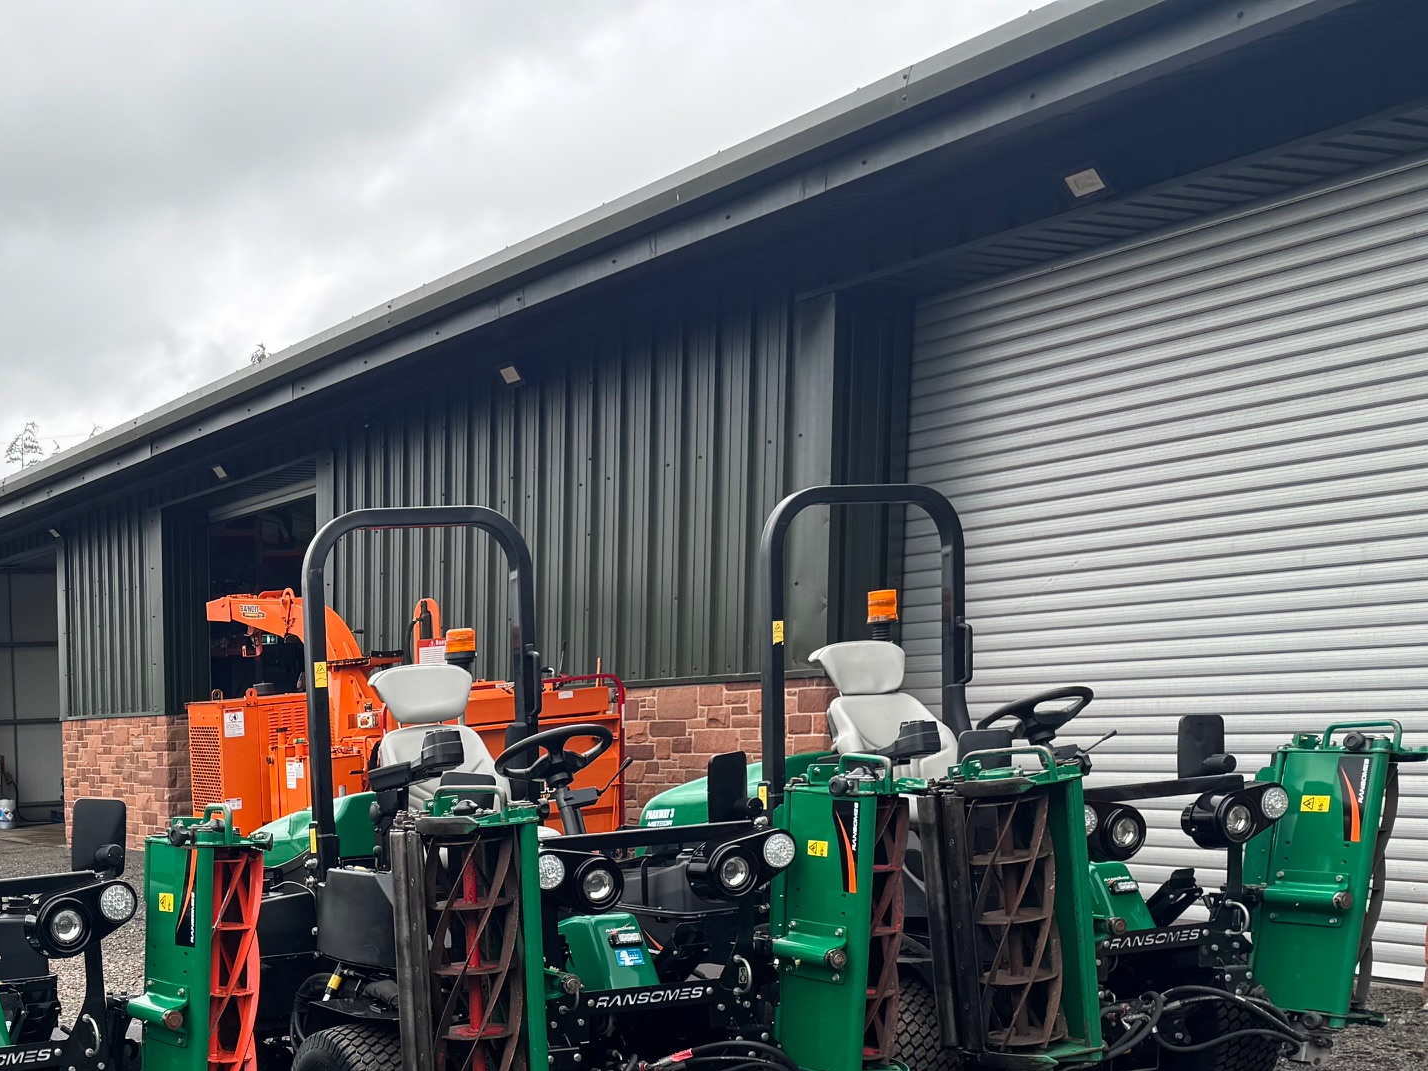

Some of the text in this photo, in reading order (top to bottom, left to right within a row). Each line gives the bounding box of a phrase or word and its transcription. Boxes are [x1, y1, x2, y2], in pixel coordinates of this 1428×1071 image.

[851, 801, 860, 852] RANSOMES
[1109, 928, 1201, 950] RANSOMES
[595, 986, 704, 1009] RANSOMES
